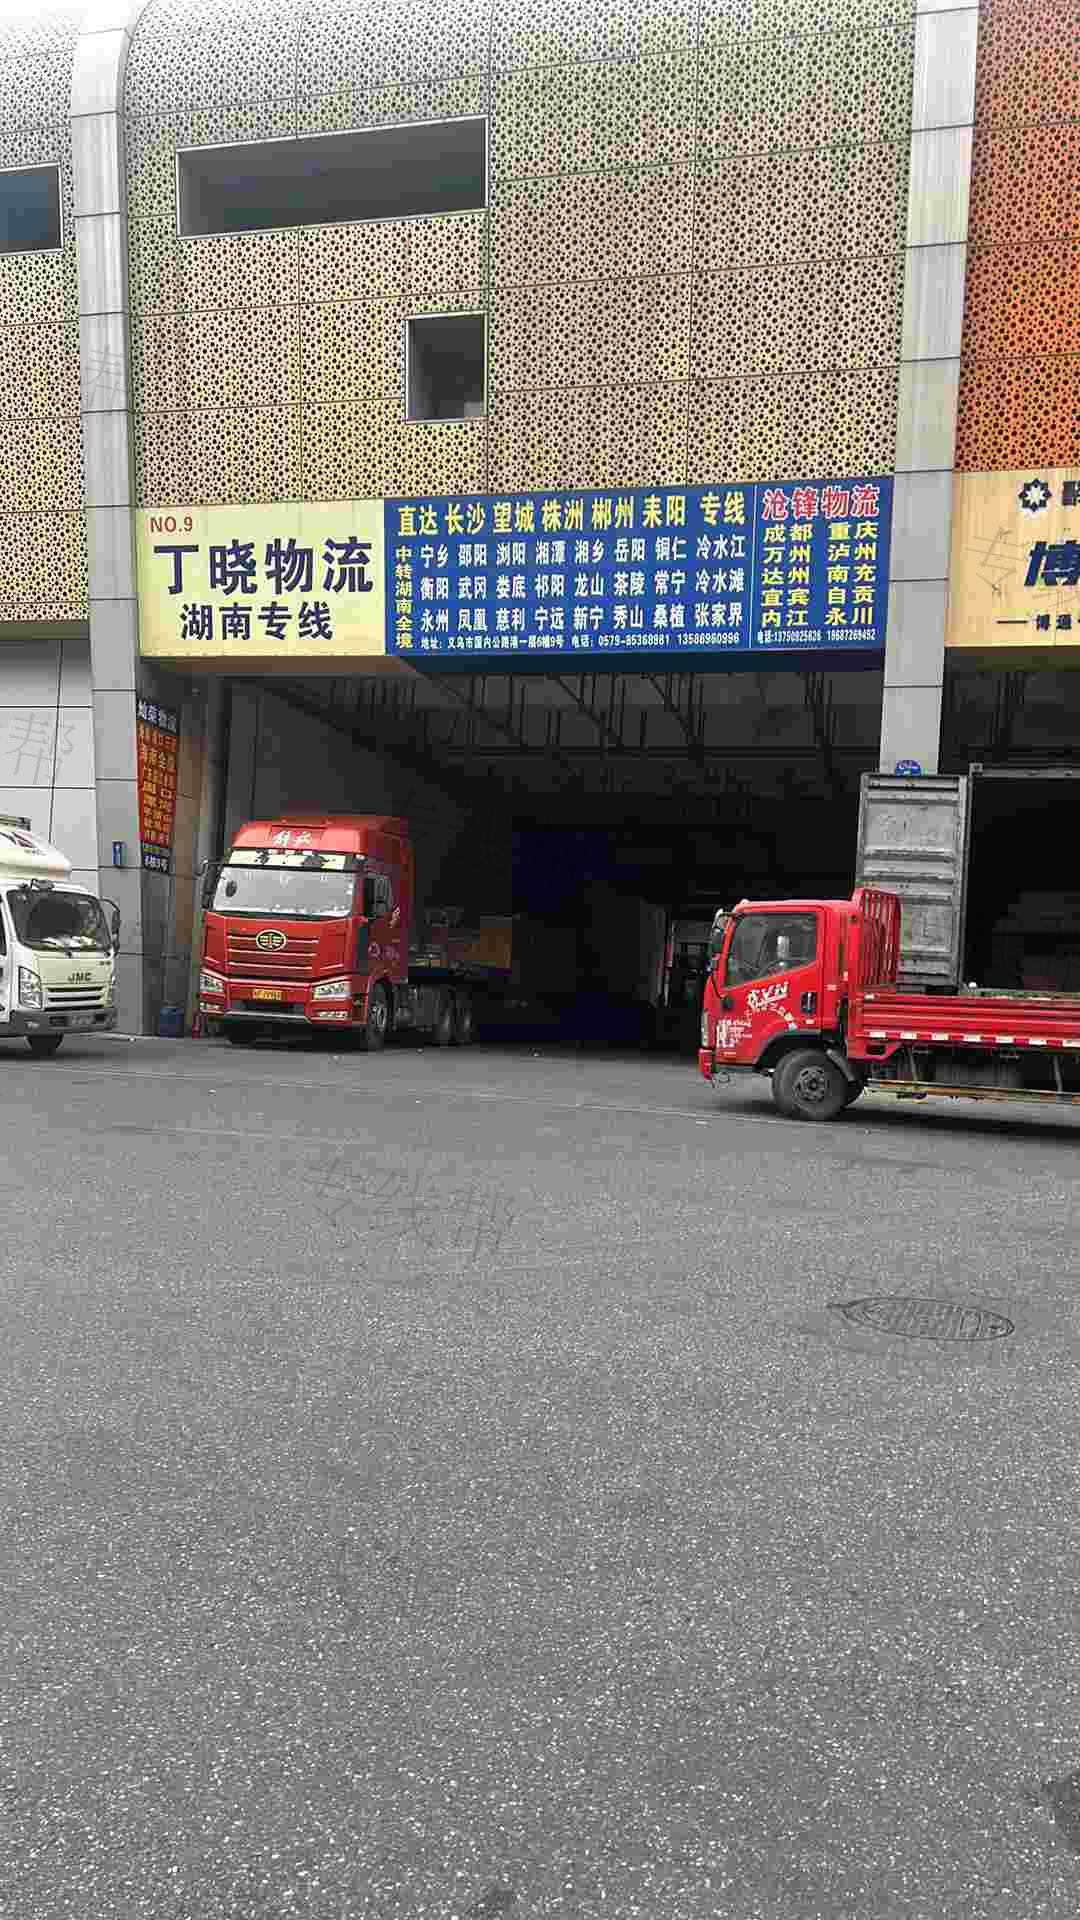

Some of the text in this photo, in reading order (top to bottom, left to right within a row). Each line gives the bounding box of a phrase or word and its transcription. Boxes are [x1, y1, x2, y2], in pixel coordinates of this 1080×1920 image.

[149, 516, 193, 533] NO.9
[398, 491, 746, 536] 直达 长沙 望城 株洲 郴州 耒阳 专线
[763, 520, 878, 543] 成都 重庆
[420, 544, 449, 568] 宁乡
[496, 542, 526, 566] 浏阳
[535, 540, 566, 565] 湘潭
[574, 539, 605, 565] 湘乡
[614, 537, 645, 563] 岳阳
[655, 535, 687, 561] 铜仁
[696, 534, 746, 560] 冷水江
[763, 542, 877, 564] 万州 泸州
[153, 536, 374, 595] 丁晓物流
[762, 564, 877, 585] 达州 南充
[420, 577, 449, 600] 衡阳
[458, 576, 487, 600] 武冈
[496, 575, 526, 599] 娄底
[574, 572, 605, 597] 龙山
[613, 571, 645, 597] 茶陵
[654, 569, 686, 595] 常宁
[695, 567, 745, 594] 冷水滩
[761, 586, 876, 607] 宜宾 自贡
[179, 601, 334, 640] 湖南专线
[420, 602, 743, 633] 永州 凤凰 慈利 宁远 新宁 秀山 桑植 张家界
[761, 607, 873, 628] 内江 永川
[67, 971, 92, 983] JMC
